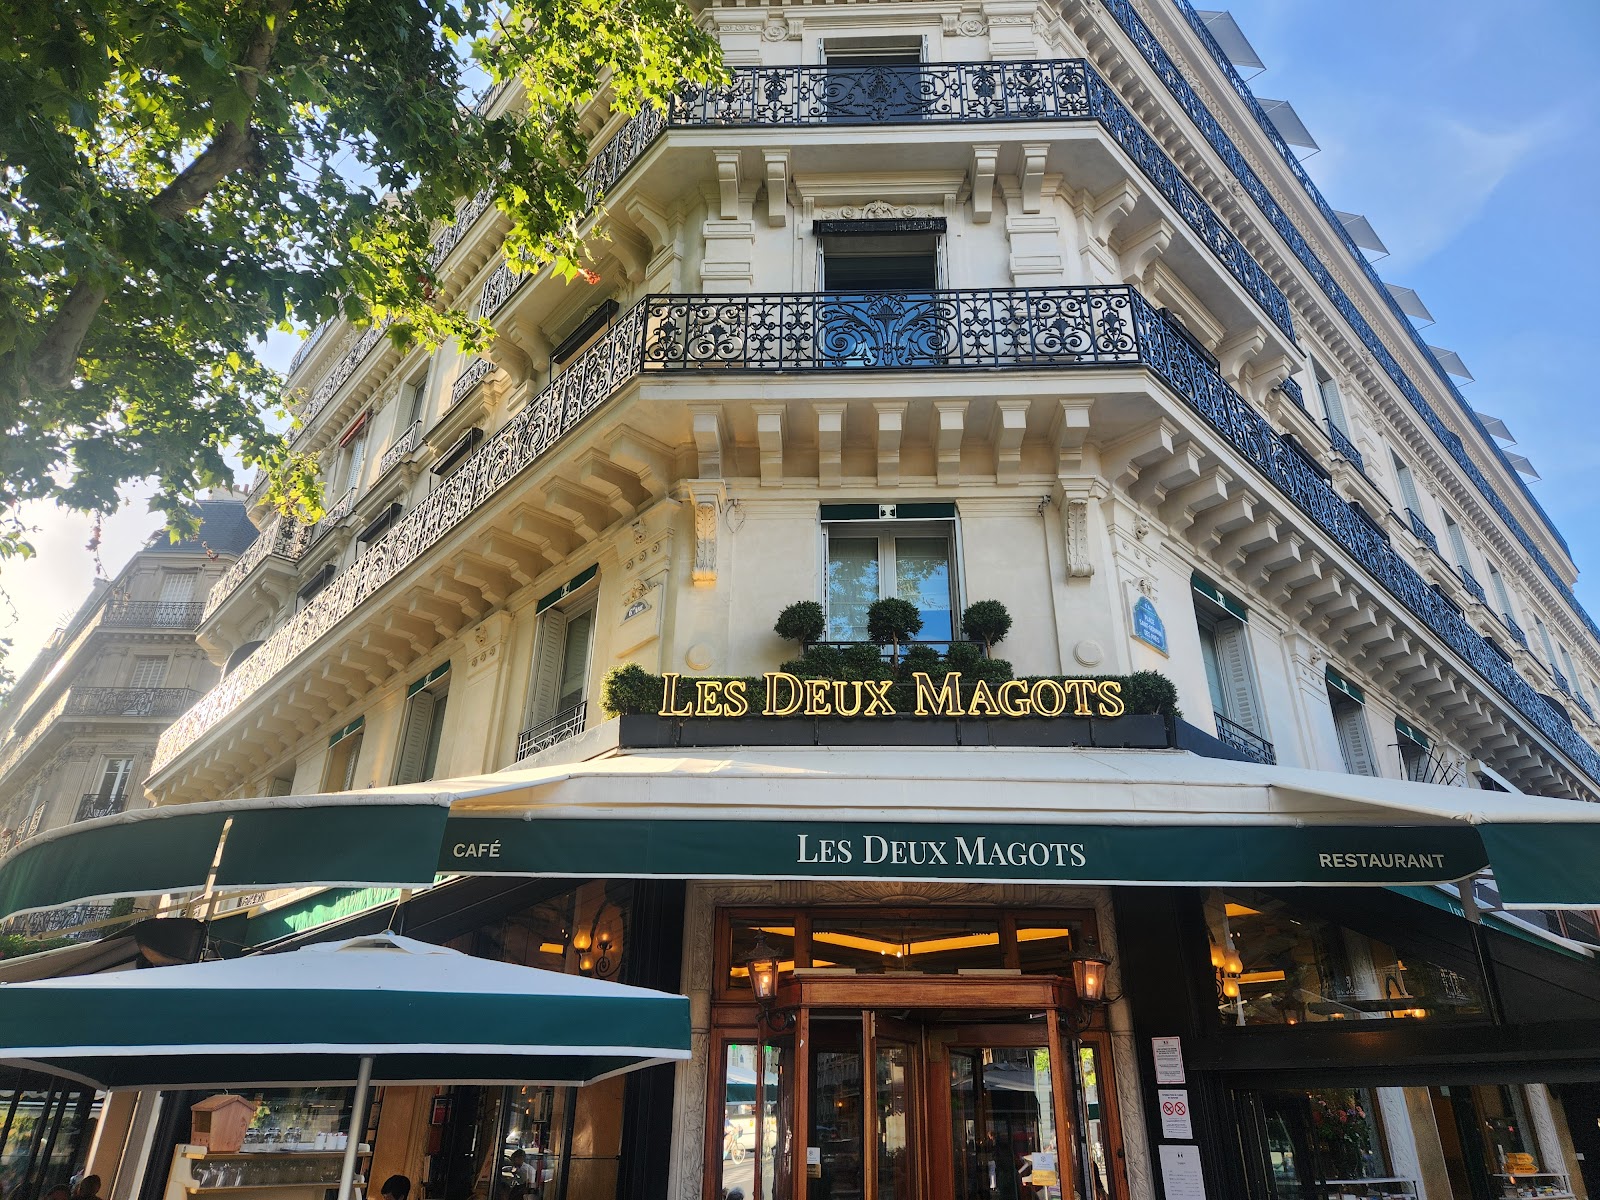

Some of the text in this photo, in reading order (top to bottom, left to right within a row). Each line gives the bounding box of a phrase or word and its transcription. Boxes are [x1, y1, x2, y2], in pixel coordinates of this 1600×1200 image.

[658, 671, 1126, 718] LES DEUX MAGOTS
[453, 840, 501, 858] CAFÉ
[797, 834, 1087, 868] LES DEUX MAGOTS
[1319, 852, 1445, 869] RESTAURANT
